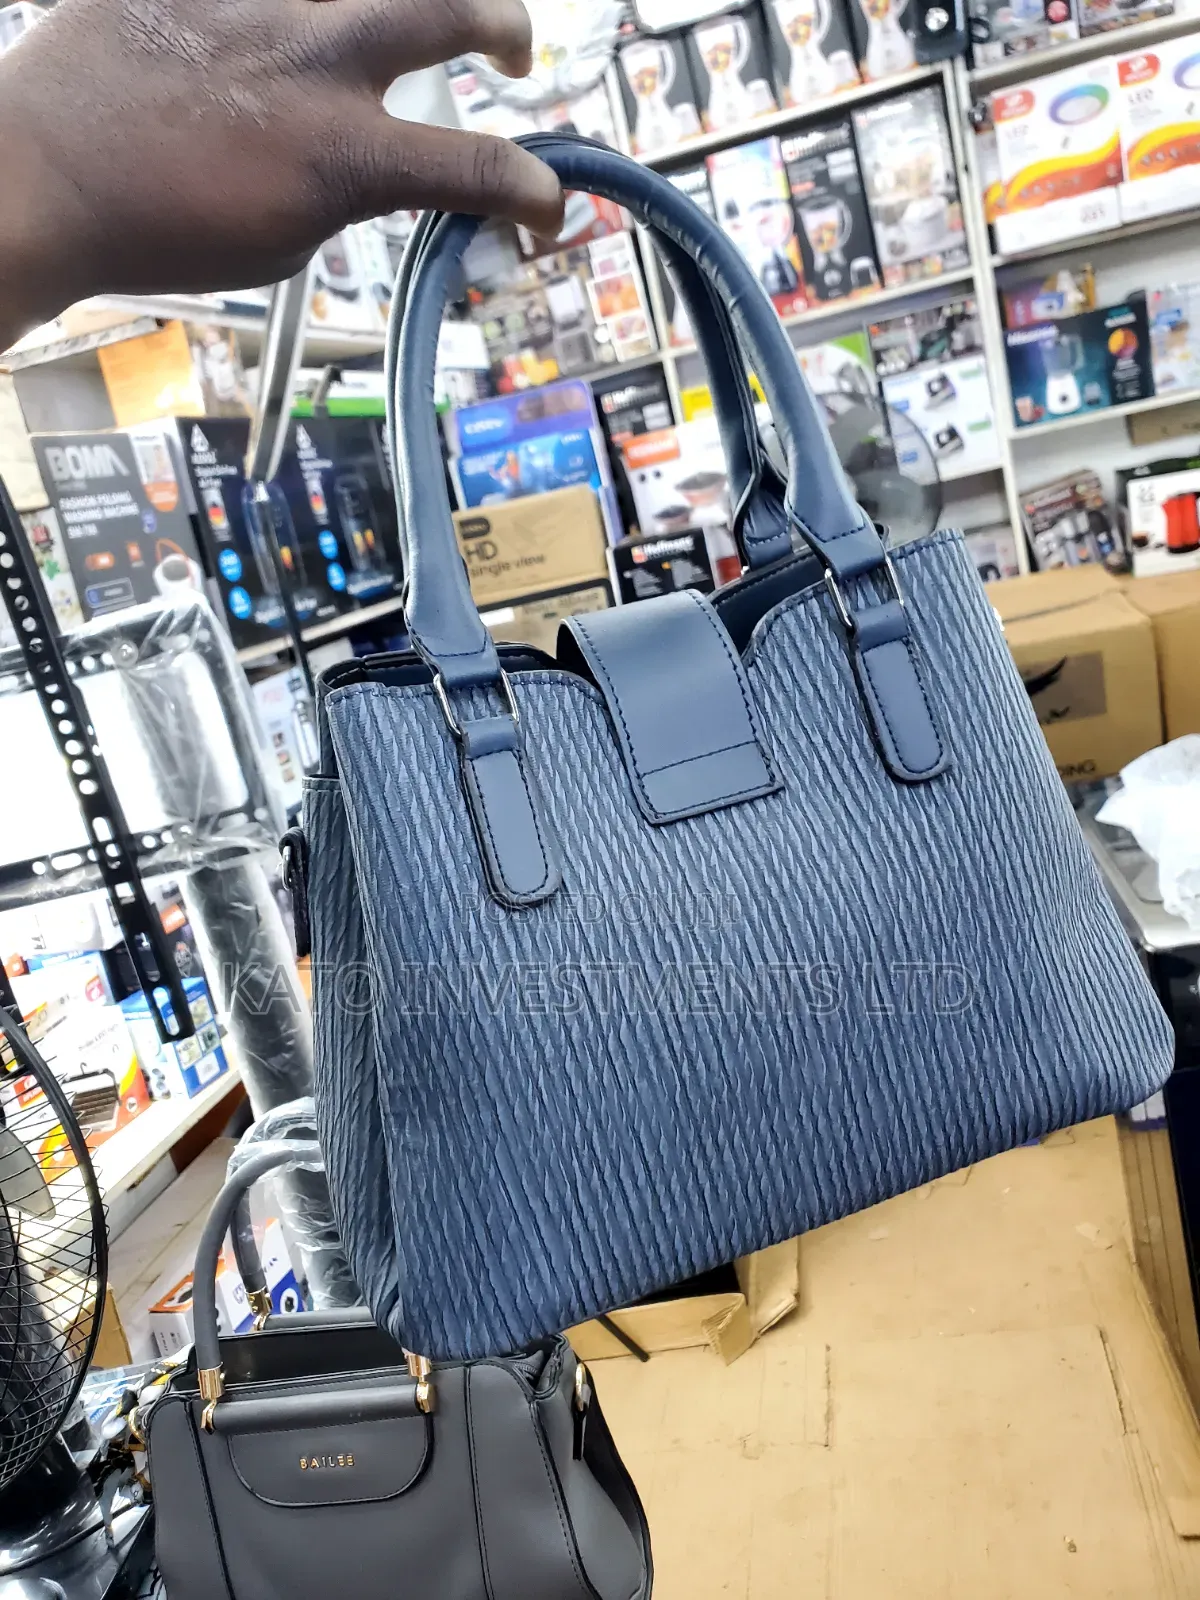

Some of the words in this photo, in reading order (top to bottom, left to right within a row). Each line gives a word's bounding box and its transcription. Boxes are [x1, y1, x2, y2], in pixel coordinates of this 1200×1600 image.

[45, 444, 130, 480] BOMA
[464, 540, 498, 563] HD
[470, 560, 513, 580] single
[299, 1454, 354, 1469] BAILEE
